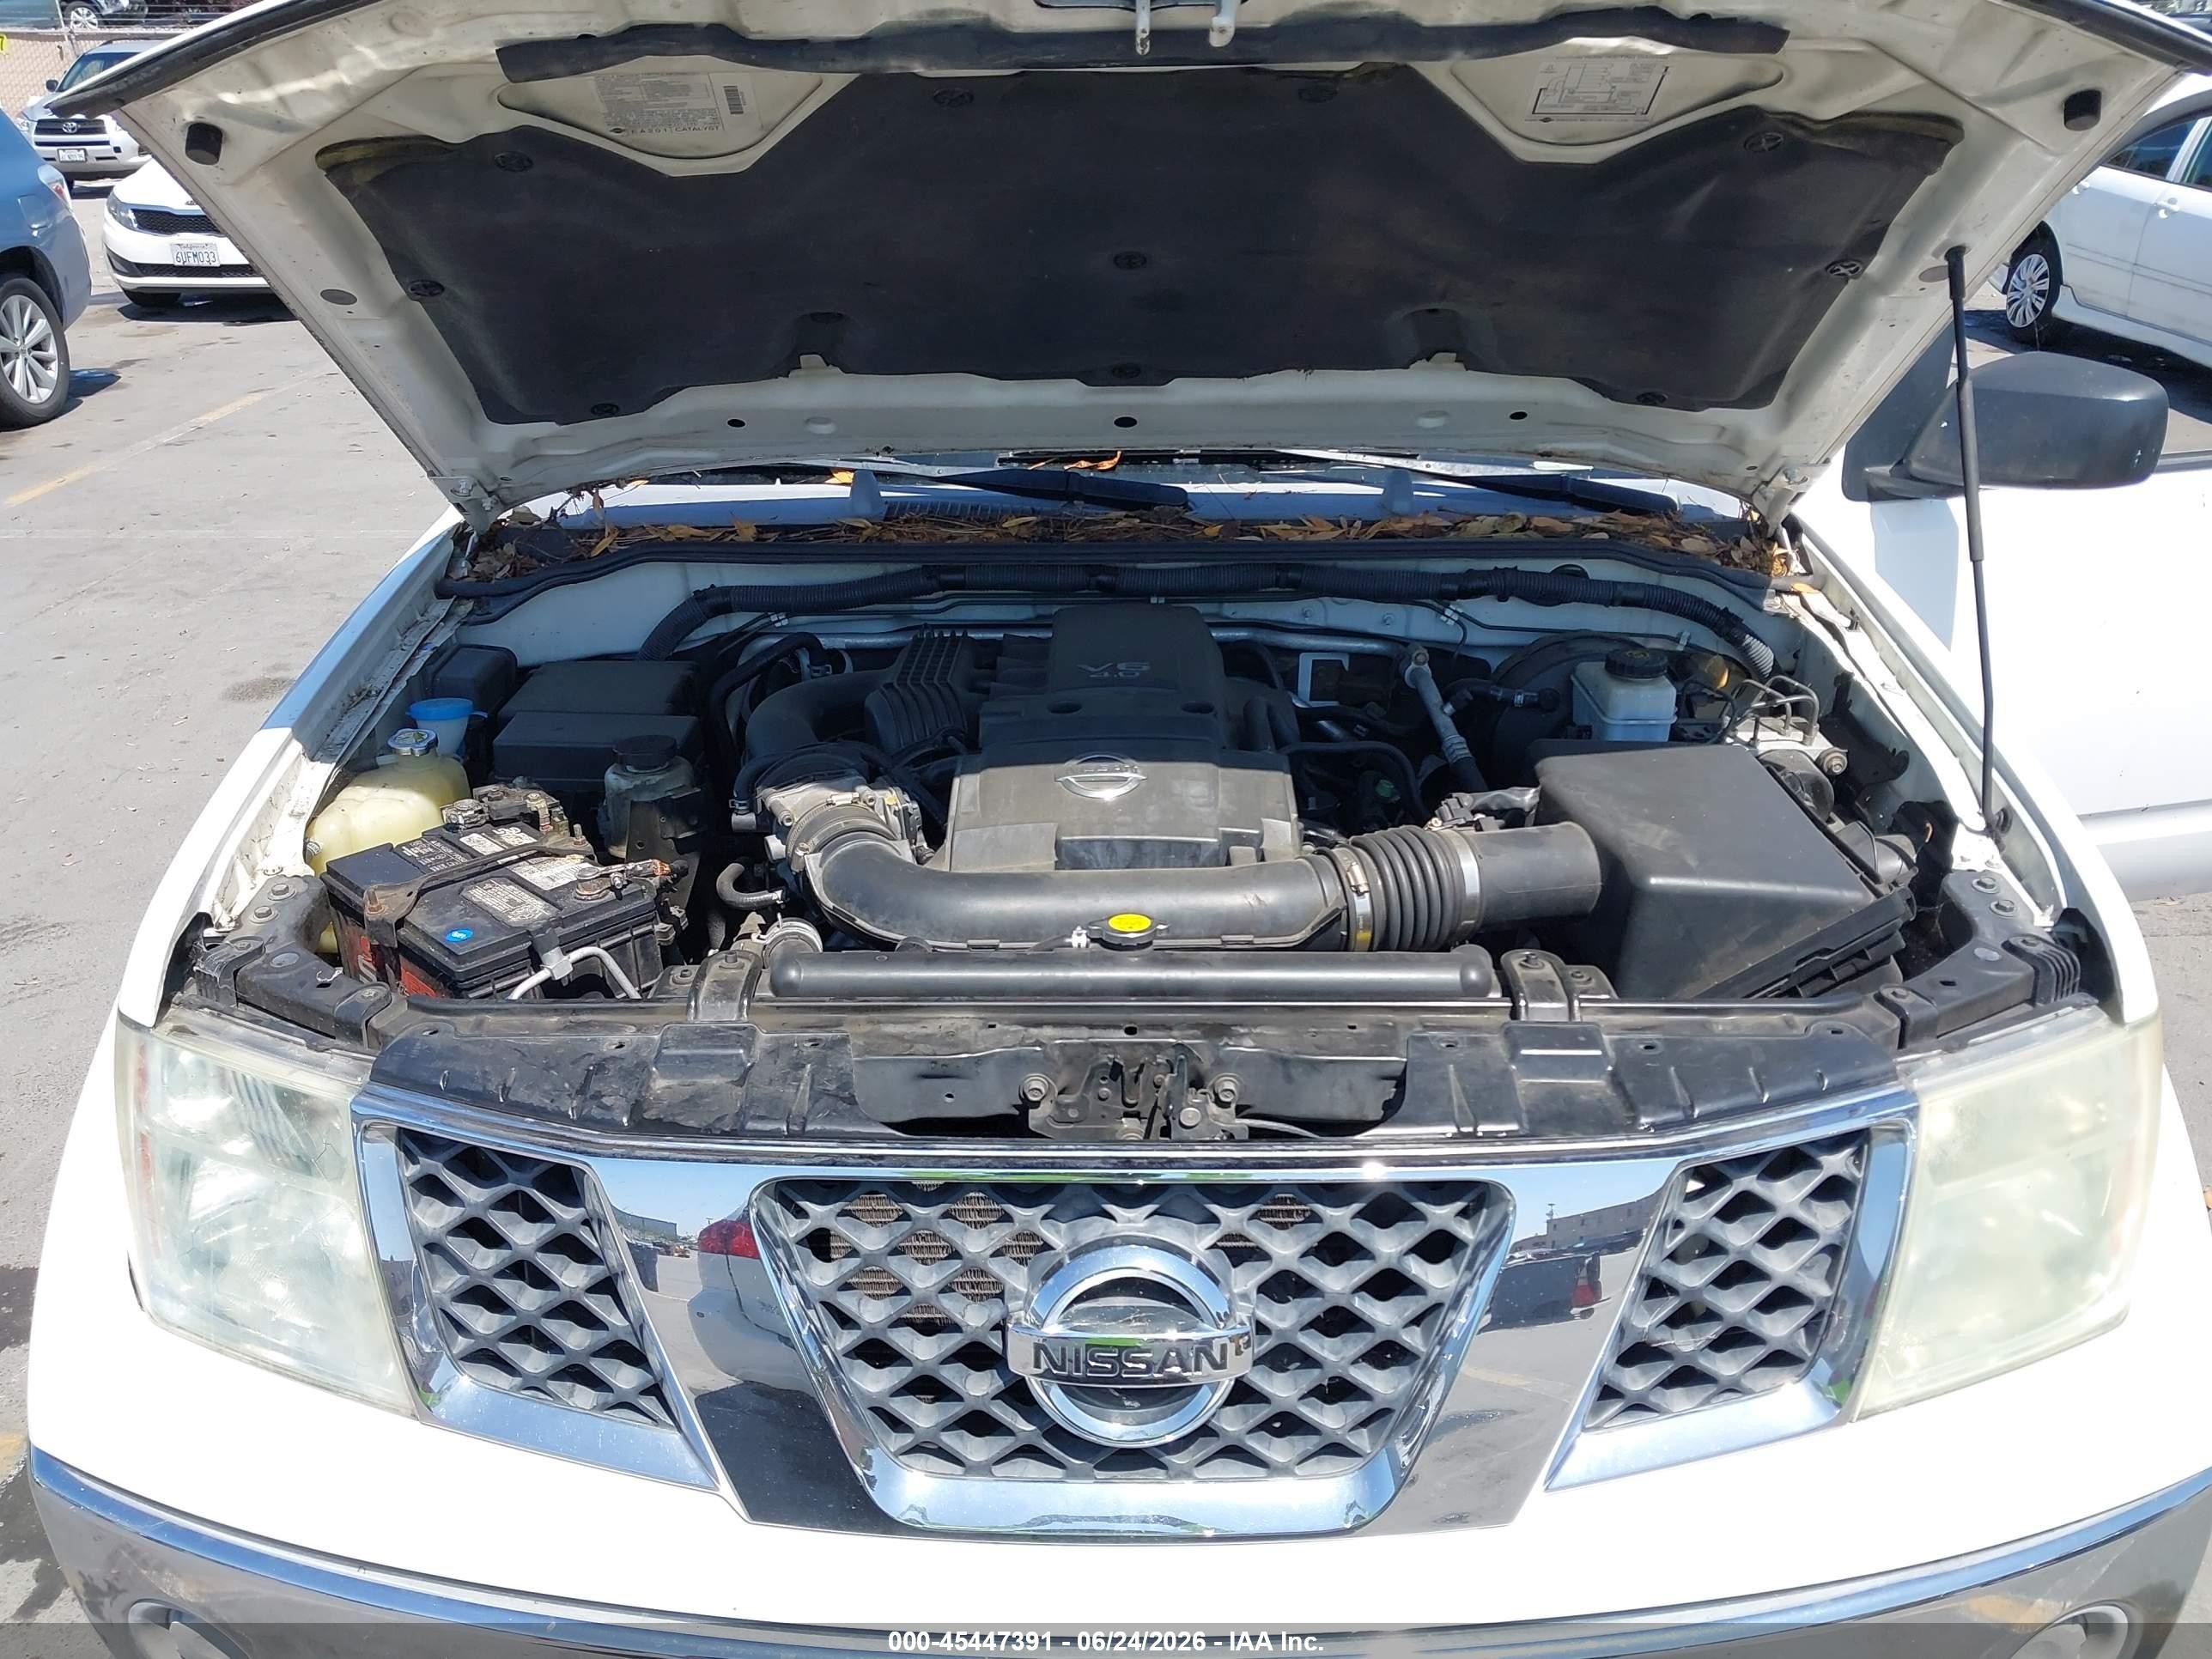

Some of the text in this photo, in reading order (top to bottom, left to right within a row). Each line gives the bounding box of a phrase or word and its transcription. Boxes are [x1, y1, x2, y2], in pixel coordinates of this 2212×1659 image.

[175, 251, 216, 263] 6UFM033
[1075, 661, 1151, 672] V6
[1033, 1342, 1228, 1378] NISSAN
